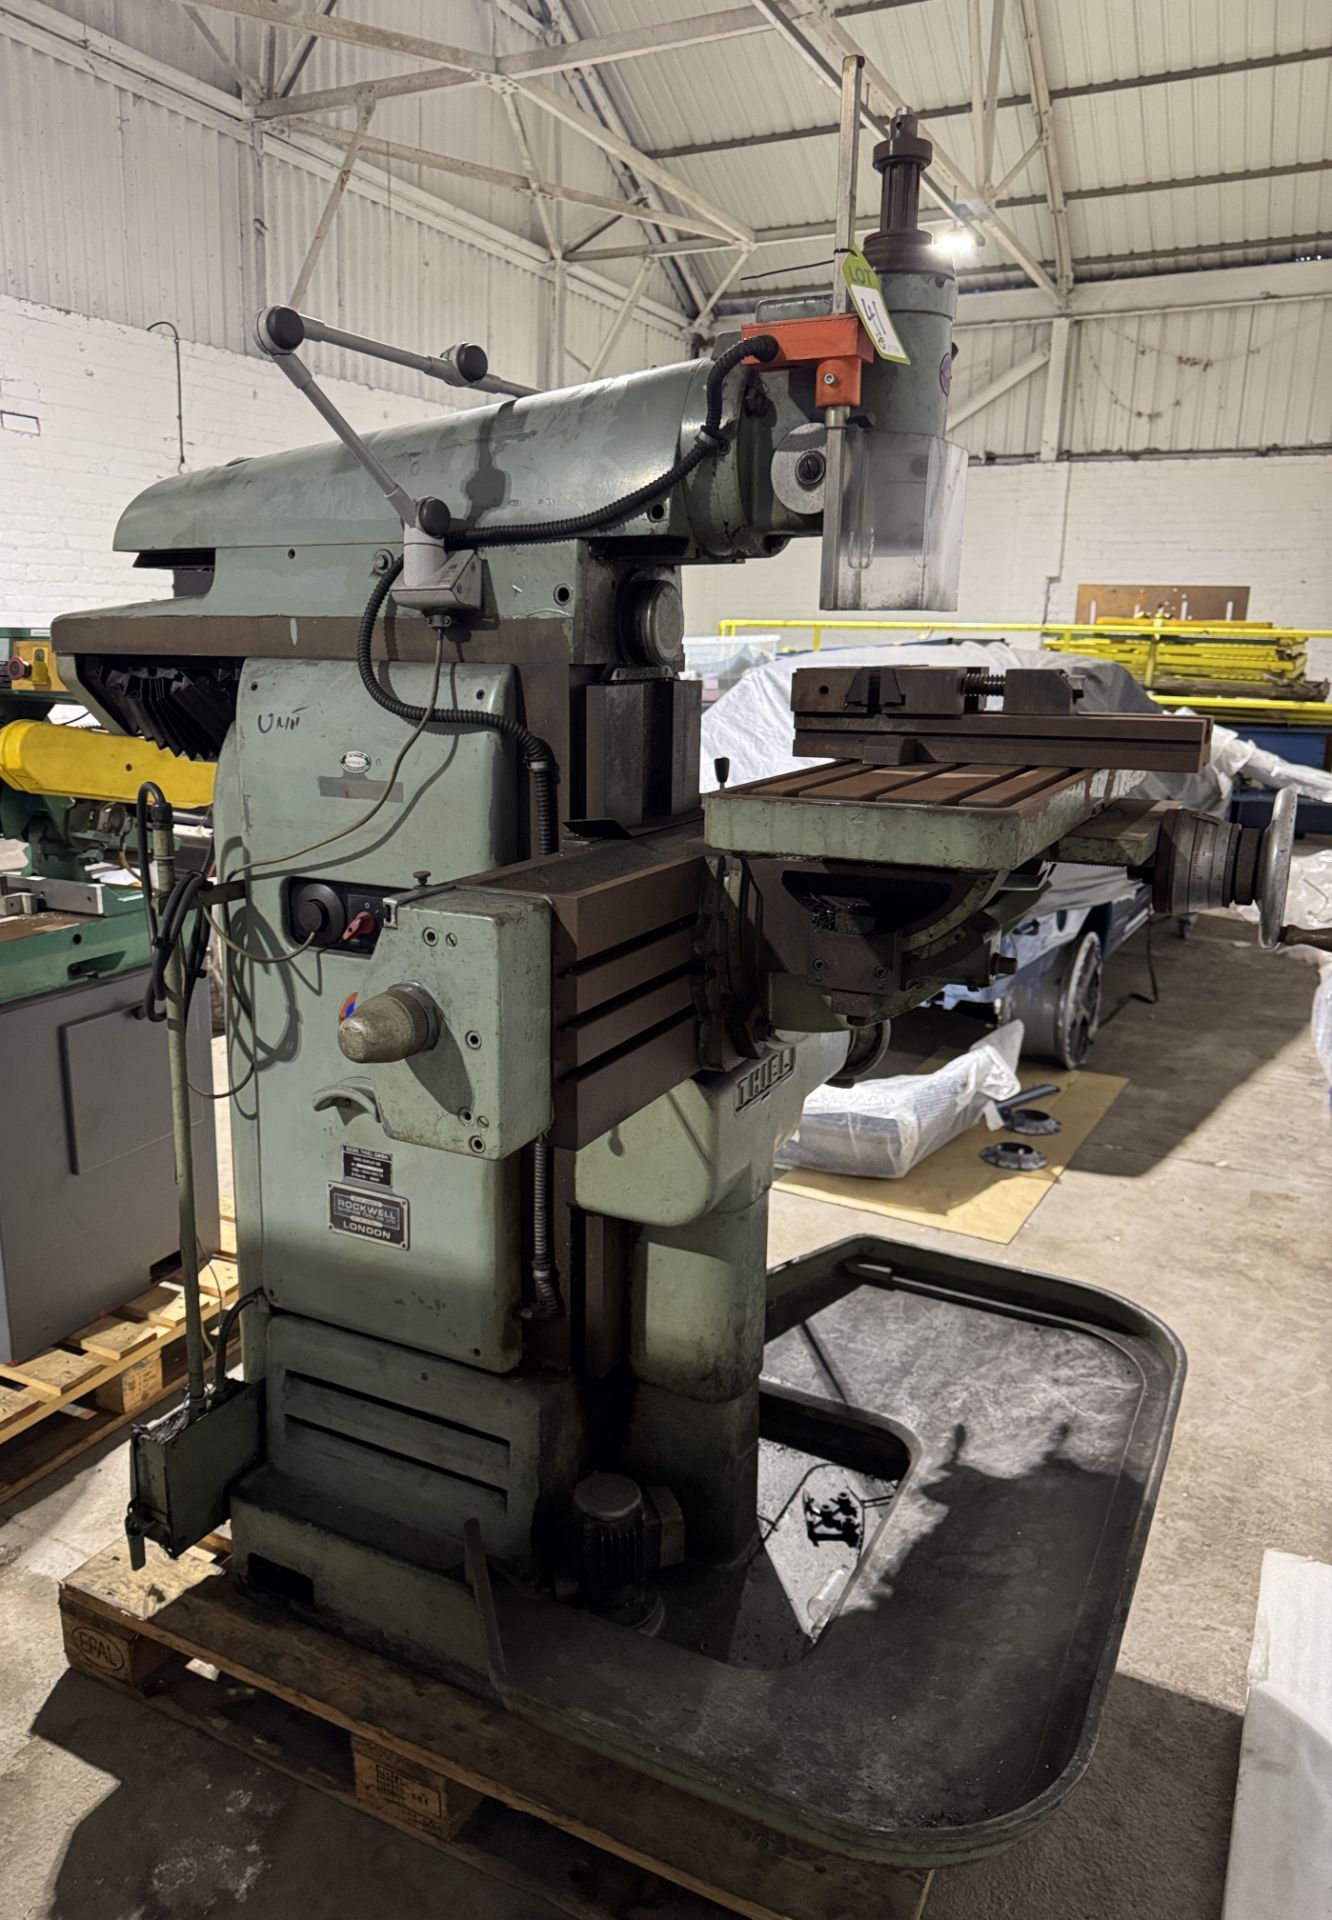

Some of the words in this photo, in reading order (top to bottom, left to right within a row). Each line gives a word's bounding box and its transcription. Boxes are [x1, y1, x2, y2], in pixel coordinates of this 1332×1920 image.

[848, 265, 871, 286] LOT
[737, 1048, 791, 1106] THIEL
[337, 1199, 396, 1219] ROCKWELL
[343, 1220, 391, 1239] LONDON
[78, 1631, 118, 1667] EPAL
